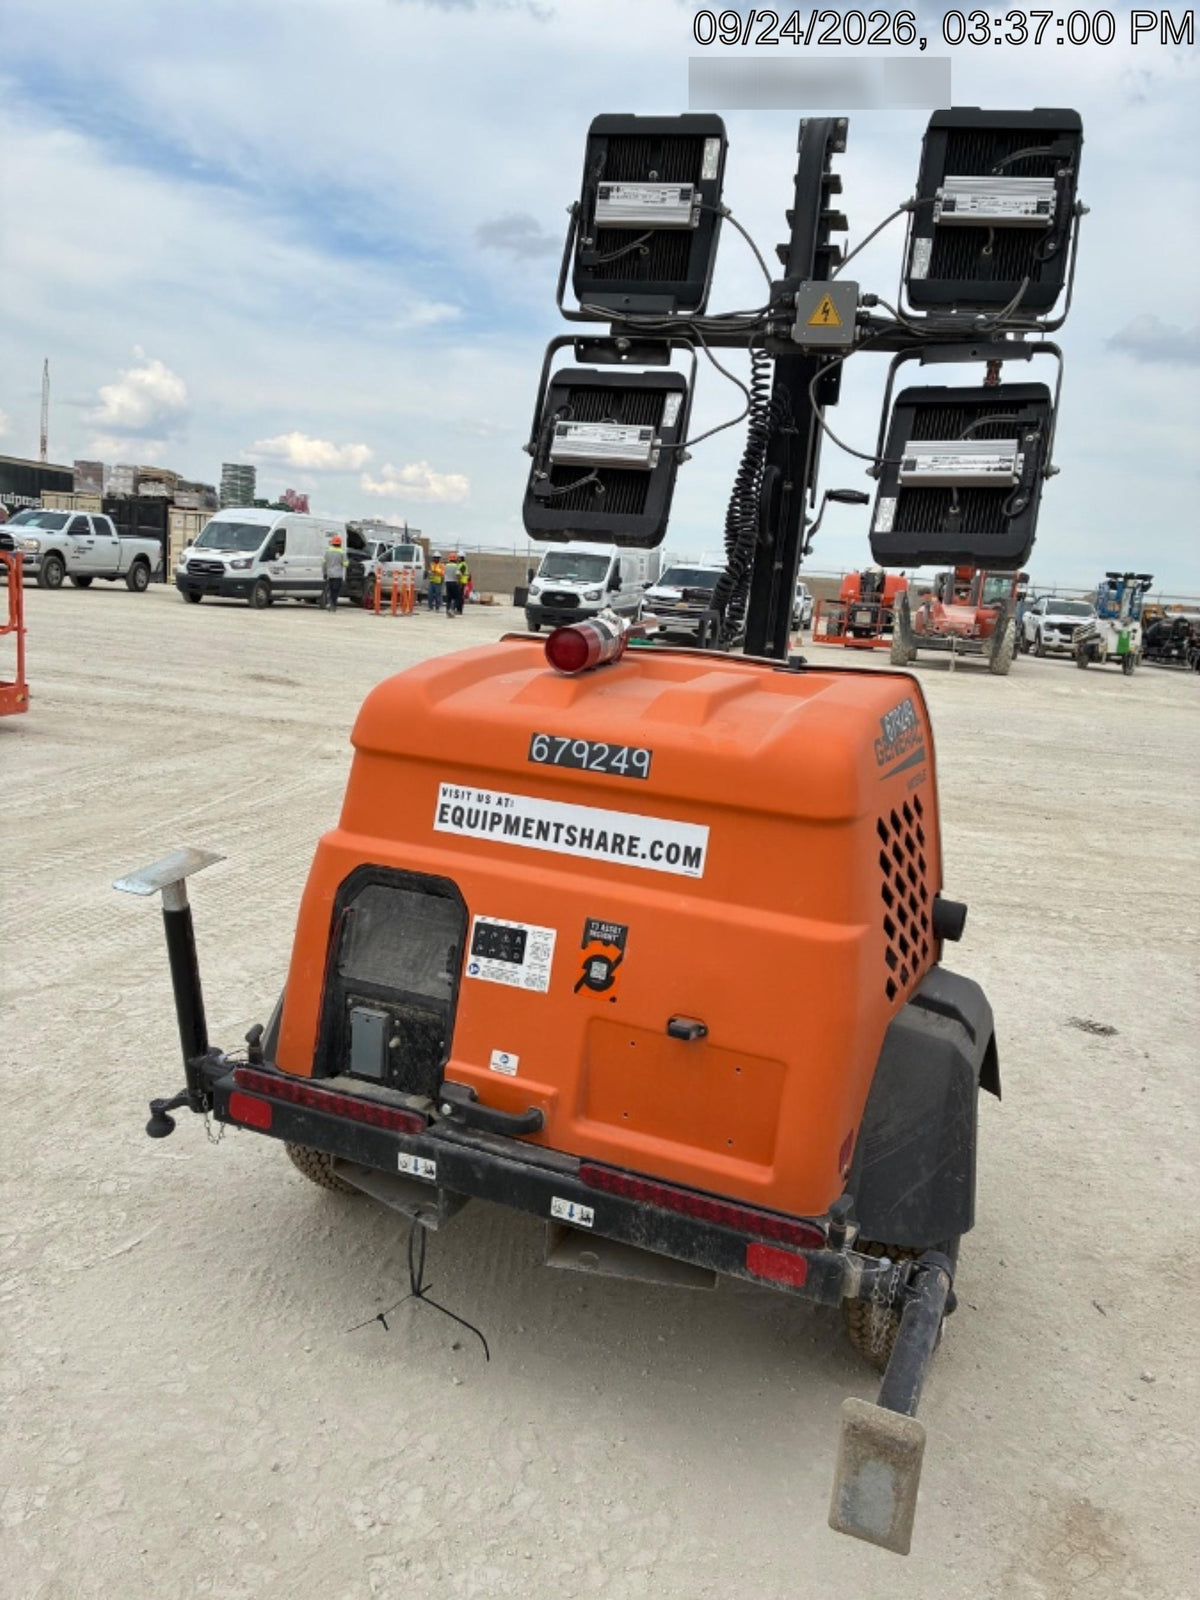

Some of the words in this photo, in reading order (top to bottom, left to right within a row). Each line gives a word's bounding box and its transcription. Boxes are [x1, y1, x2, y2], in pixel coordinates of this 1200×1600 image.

[531, 734, 649, 778] 679249
[441, 786, 472, 801] VISIT
[476, 793, 492, 805] US
[495, 796, 515, 808] AT:
[438, 804, 702, 868] EQUIPMENTSHARE.COM
